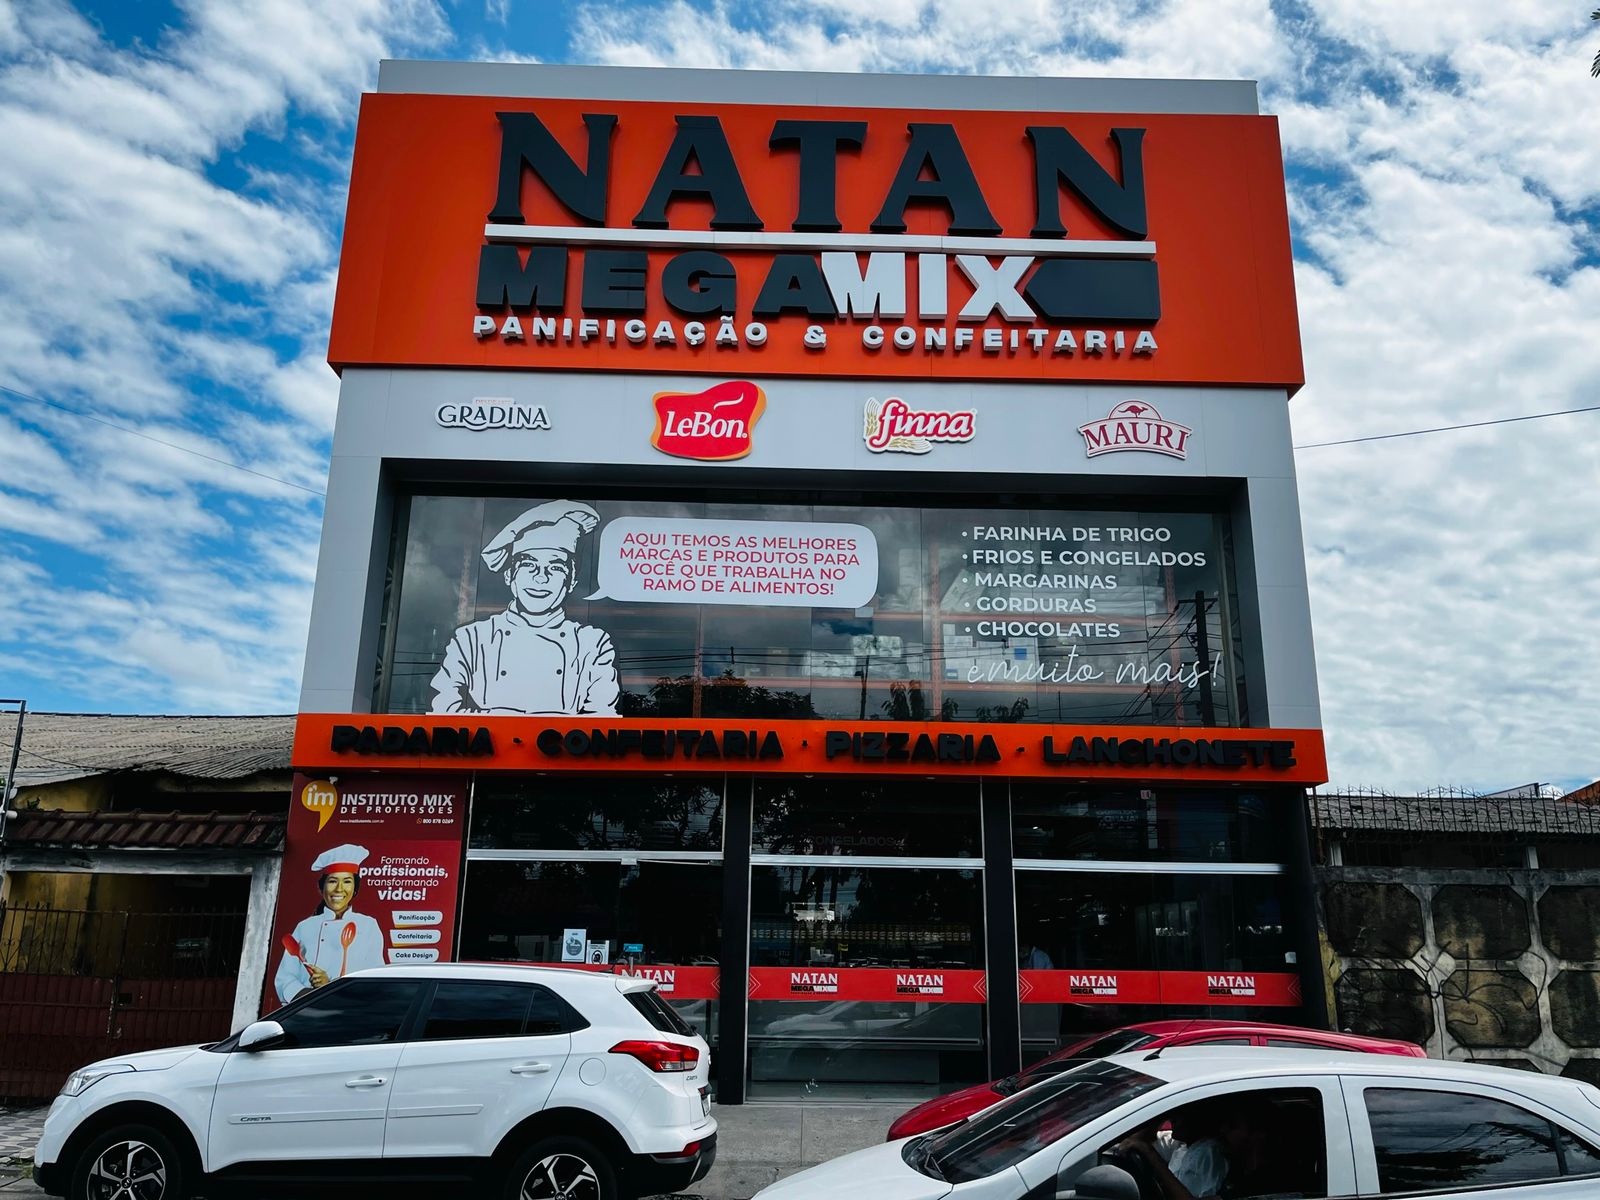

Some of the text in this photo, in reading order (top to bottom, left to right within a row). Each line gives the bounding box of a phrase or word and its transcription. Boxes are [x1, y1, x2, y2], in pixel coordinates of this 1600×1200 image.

[487, 111, 1148, 241] NATAN
[477, 245, 1038, 322] MEGAMIX
[473, 314, 1159, 354] PANIFICAÇÃO & CONFEITARIA
[437, 404, 548, 429] GRADINA
[663, 409, 742, 439] LeBon
[868, 399, 973, 449] finna
[1083, 421, 1188, 452] MAURI
[623, 532, 857, 551] AQUI TEMOS AS MELHORES
[973, 526, 1172, 543] FARINHA DE TRIGO
[620, 547, 860, 566] MARCAS E PRODUTOS PARA
[973, 549, 1207, 567] FRIOS E CONGELADOS
[627, 560, 846, 581] VOCÊ QUE TRABALHA NO
[643, 578, 834, 596] RAMO DE ALIMENTOS!
[975, 572, 1118, 590] MARGARINAS
[977, 597, 1097, 614] GORDURAS
[977, 621, 1121, 638] CHOCOLATES
[1115, 653, 1221, 689] mais!
[331, 725, 1297, 768] PADARIA CONFEITARIA PIZZARIA LANCHONETE
[341, 793, 453, 806] INSTITUTO MIX
[340, 805, 453, 814] DE PROFISSÕES
[380, 855, 430, 865] Formando
[359, 865, 449, 879] profissionais,
[367, 877, 439, 887] transformando
[377, 887, 427, 901] vidas!
[398, 914, 436, 922] Panificação
[412, 952, 434, 960] Design
[791, 972, 838, 985] NATAN
[896, 974, 944, 986] NATAN
[1069, 975, 1117, 988] NATAN
[1207, 975, 1255, 988] NATAN
